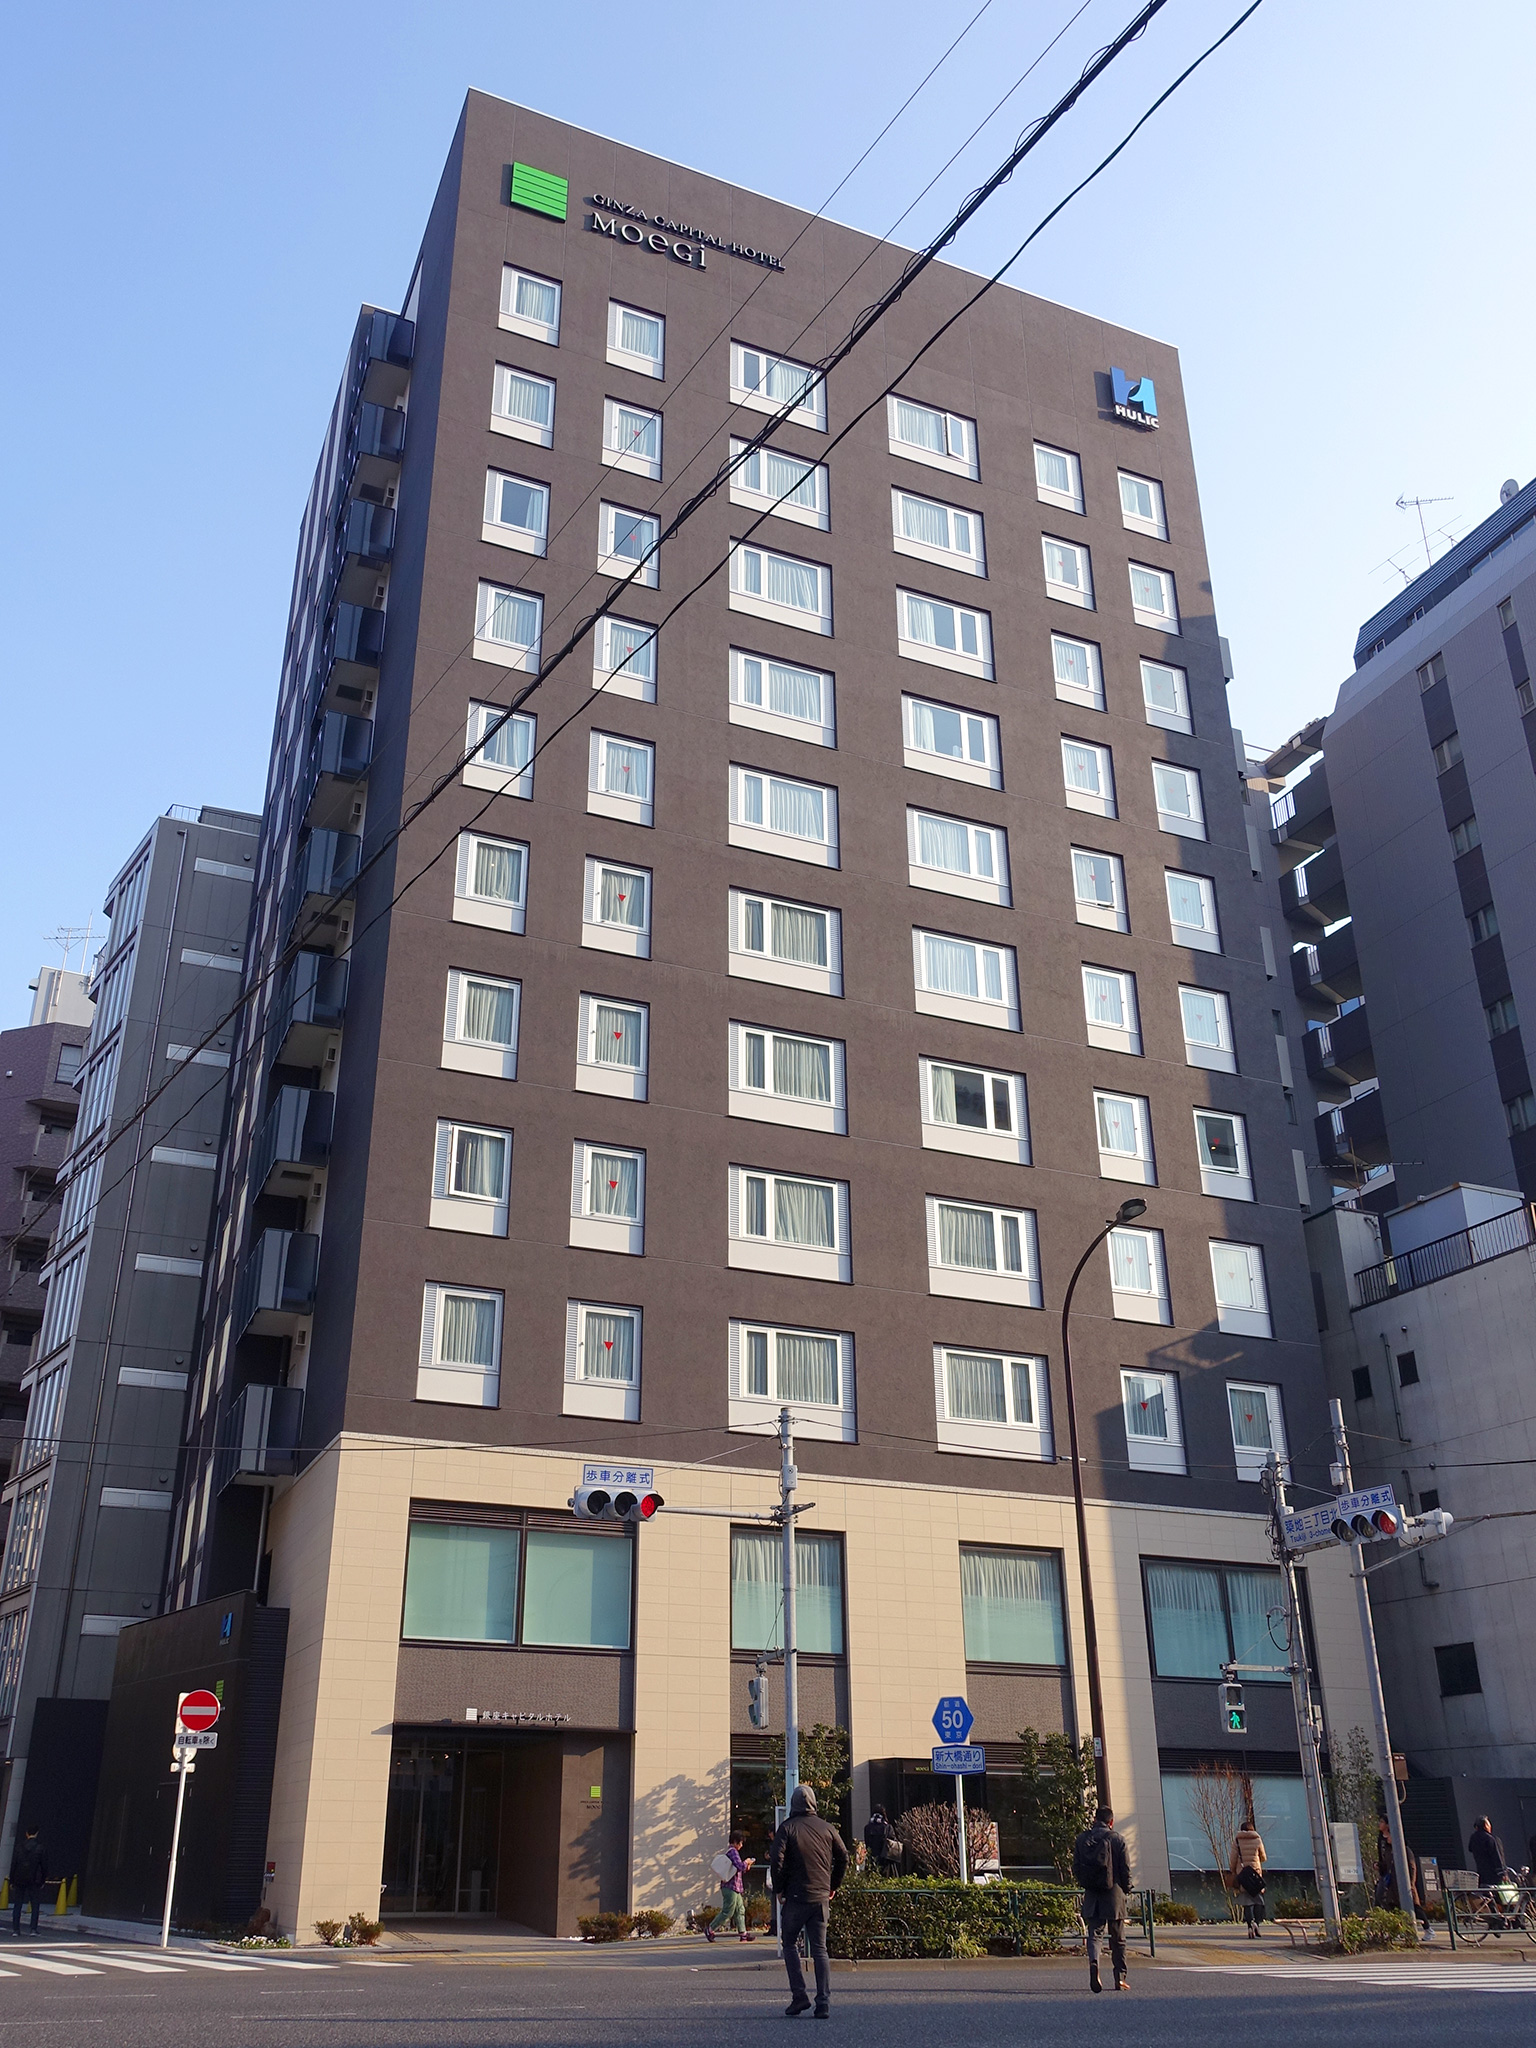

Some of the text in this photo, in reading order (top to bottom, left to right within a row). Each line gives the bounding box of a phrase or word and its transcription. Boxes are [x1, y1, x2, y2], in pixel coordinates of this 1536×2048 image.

[592, 193, 787, 270] GINZA CAPITAL HOTEL
[1115, 404, 1160, 429] HULIC
[586, 1469, 650, 1485] 歩車分離式
[1341, 1490, 1391, 1511] 歩車分離式
[941, 1709, 964, 1729] 50
[178, 1735, 215, 1745] 自転車を除く
[935, 1750, 981, 1762] 新大橋通り
